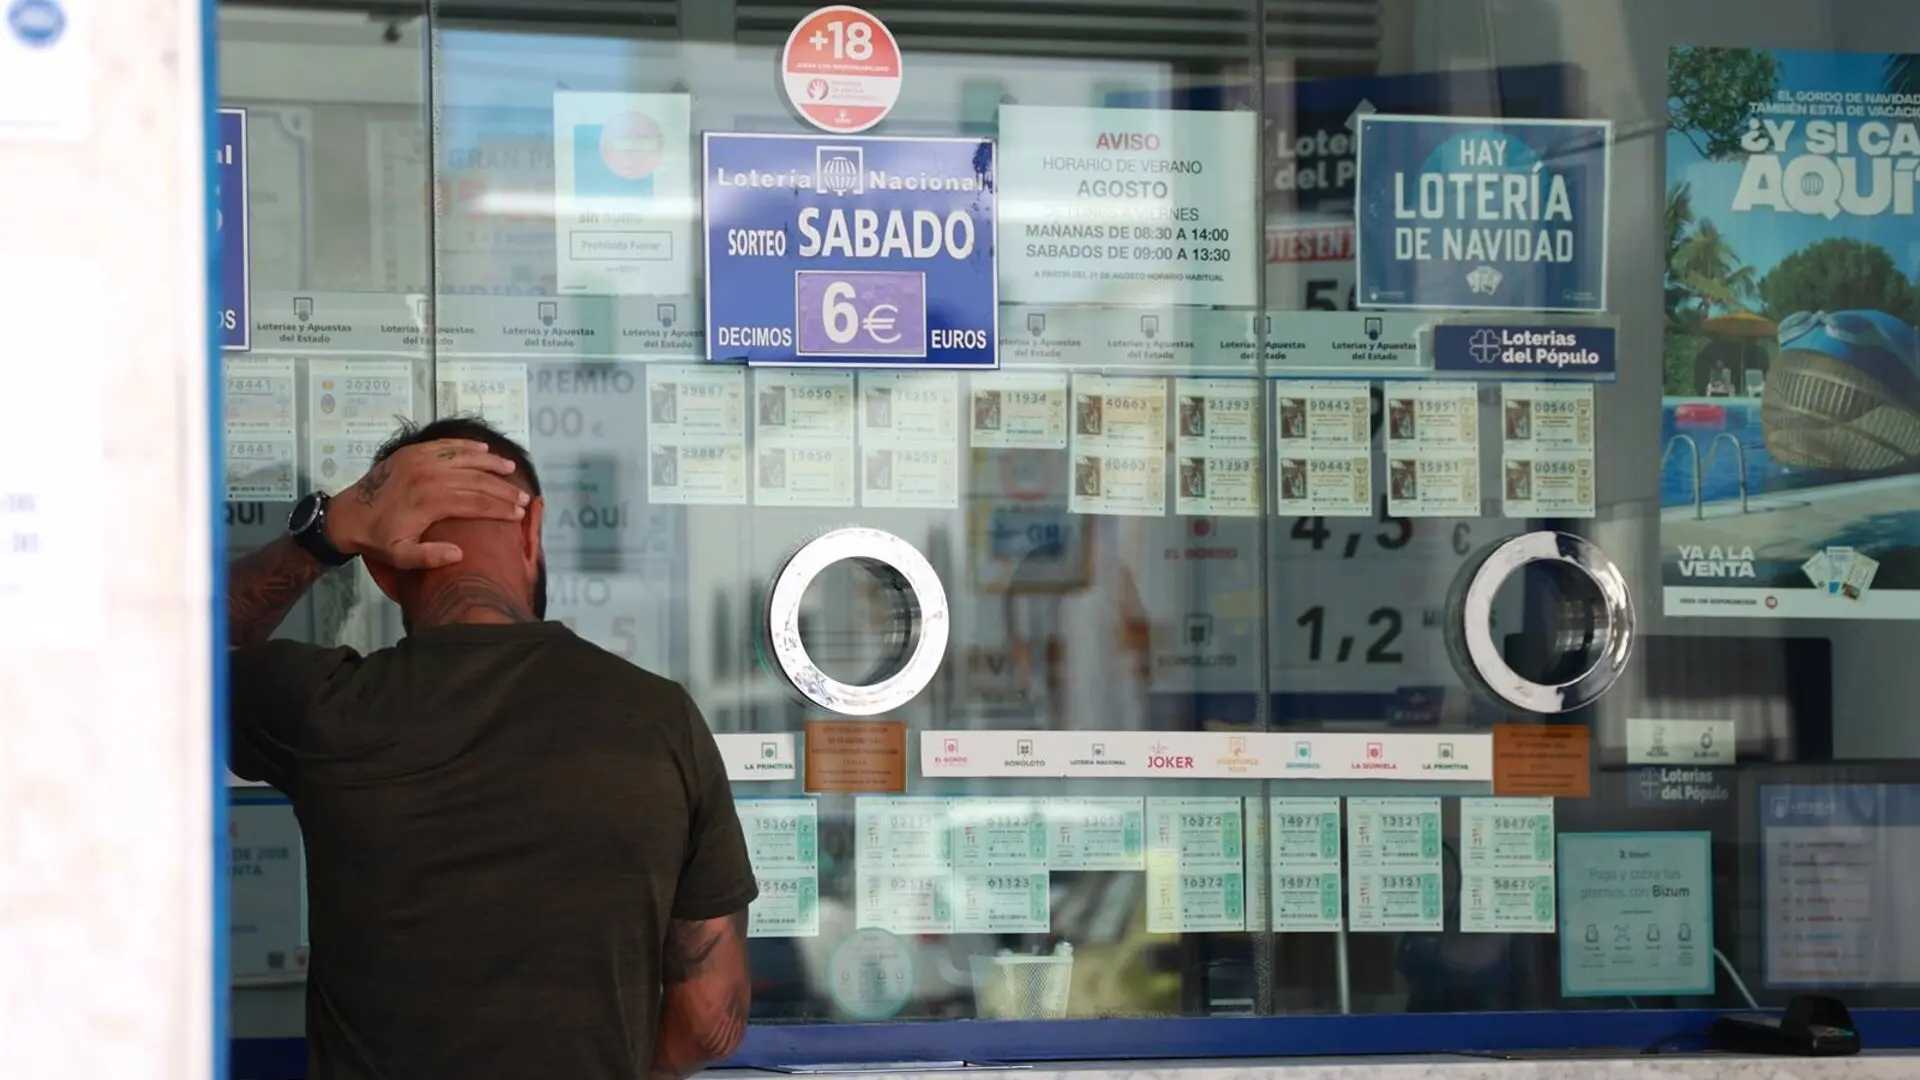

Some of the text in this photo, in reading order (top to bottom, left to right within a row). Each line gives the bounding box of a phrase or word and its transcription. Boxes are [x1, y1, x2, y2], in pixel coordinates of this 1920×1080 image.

[809, 21, 873, 61] +18
[1778, 91, 1793, 102] EL
[1796, 92, 1843, 103] GORDO
[1845, 93, 1862, 104] DE
[1749, 101, 1807, 114] TAMBIÉN
[1809, 101, 1844, 116] ESTÁ
[1846, 105, 1864, 116] DE
[1096, 132, 1160, 150] AVISO
[1741, 118, 1796, 153] ¿Y
[1805, 120, 1848, 154] SI
[1276, 131, 1356, 158] Lote
[1460, 140, 1507, 166] HAY
[1042, 156, 1203, 175] HORARIO DE VERANO
[869, 170, 984, 192] Nacional
[1077, 179, 1168, 200] AGOSTO
[1394, 160, 1573, 221] LOTERÍA
[728, 207, 975, 260] SORTEO SABADO
[1025, 222, 1229, 242] MAÑANAS DE 08:30 A 14:00
[1395, 227, 1431, 260] DE
[1443, 228, 1573, 262] NAVIDAD
[1025, 244, 1231, 262] SABADOS DE 09:00 A 13:30
[1112, 272, 1145, 281] AGOSTO
[1147, 273, 1183, 282] HORARIO
[1186, 273, 1224, 283] HABITUAL
[821, 281, 902, 344] 6€
[307, 322, 352, 333] Apuestas
[552, 327, 595, 338] Apuestas
[671, 329, 705, 339] Apuest
[279, 335, 331, 344] del Estado
[403, 337, 418, 346] del
[525, 338, 574, 348] del Estado
[644, 340, 693, 349] del Estado
[718, 327, 987, 350] DECIMOS EUROS
[1040, 339, 1080, 348] Apuestas
[1154, 340, 1194, 349] Apuestas
[1264, 341, 1306, 352] Apuestas
[1377, 342, 1416, 351] Apuestas
[1014, 349, 1061, 359] del Estado
[1127, 351, 1174, 360] del Estado
[1352, 353, 1398, 361] del Estado
[1502, 347, 1599, 368] del Pópulo
[345, 380, 391, 391] 26200
[529, 369, 635, 395] REMIO
[1005, 392, 1047, 404] 11934
[1105, 398, 1147, 410] 40663
[1310, 400, 1351, 412] 90442
[1310, 461, 1351, 472] 90442
[1678, 544, 1755, 561] YA A LA
[1678, 560, 1756, 578] VENTA
[1297, 606, 1404, 664] 1,2
[756, 763, 794, 771] PRIMITIVA
[1147, 755, 1194, 769] JOKER
[1661, 785, 1683, 800] del
[1182, 815, 1222, 828] 16372
[1280, 815, 1320, 828] 14971
[1589, 868, 1617, 882] Paga
[1620, 871, 1627, 882] y
[1630, 869, 1661, 880] cobra
[1183, 877, 1224, 889] 16372
[1280, 877, 1321, 889] 14971
[1381, 877, 1422, 889] 13121
[1652, 884, 1690, 898] Bizum
